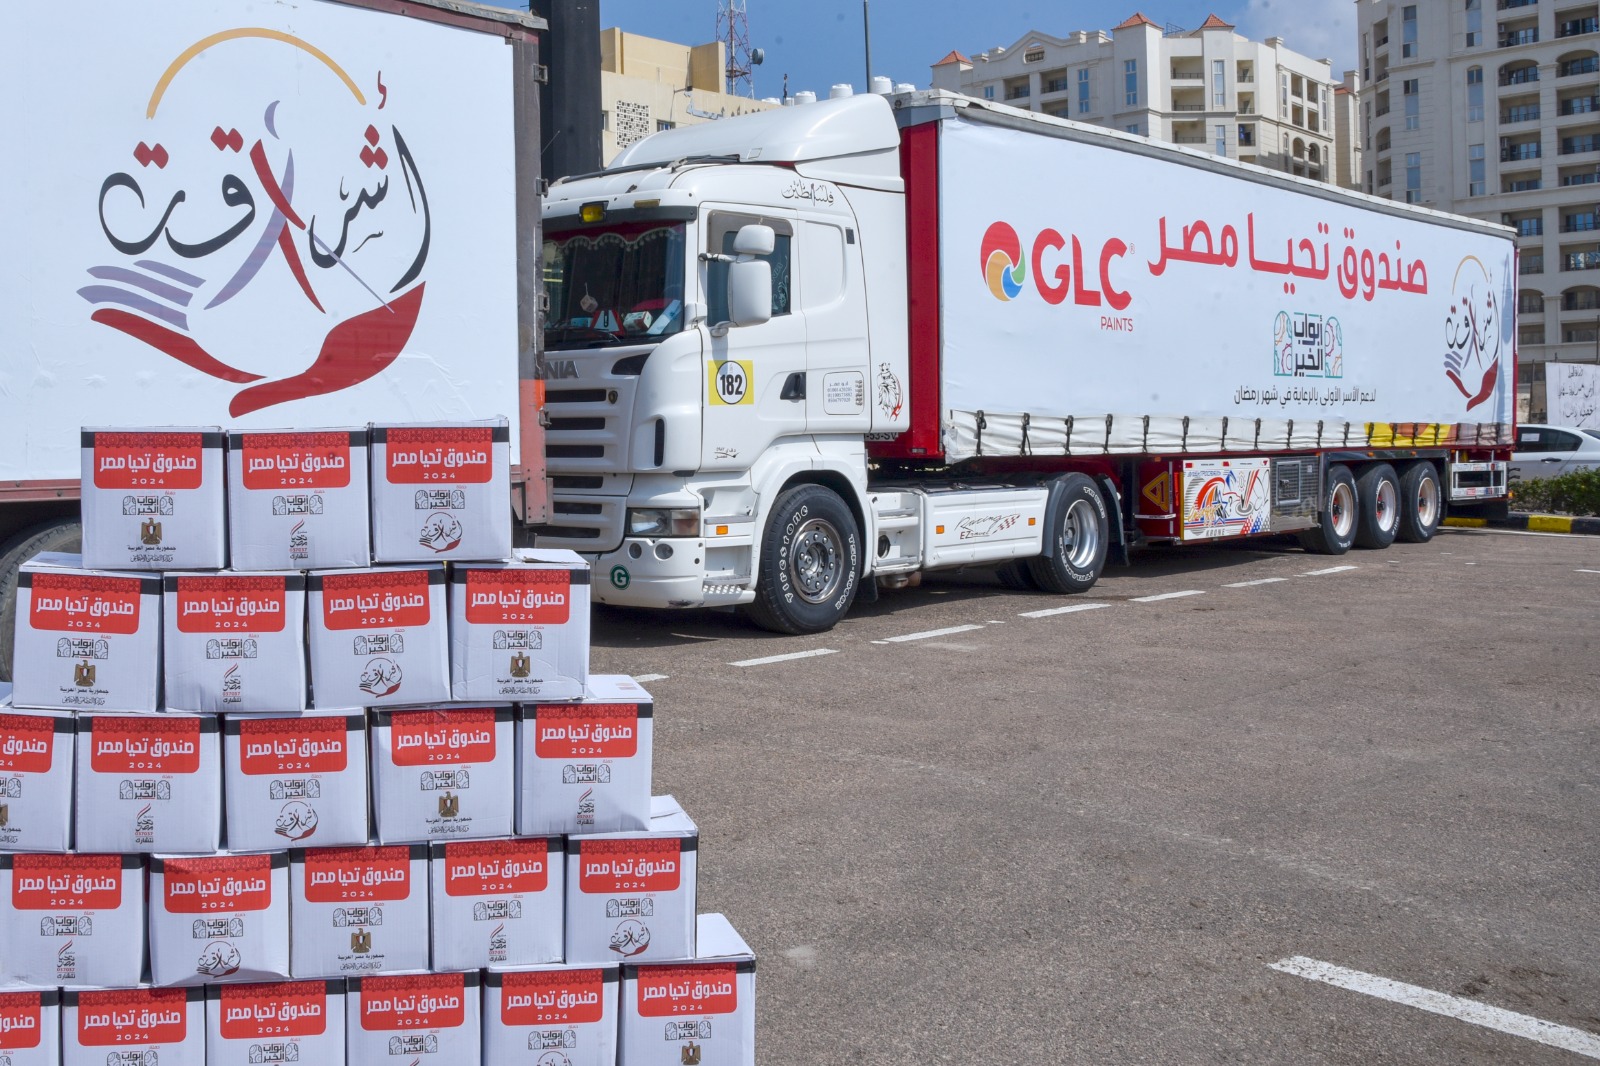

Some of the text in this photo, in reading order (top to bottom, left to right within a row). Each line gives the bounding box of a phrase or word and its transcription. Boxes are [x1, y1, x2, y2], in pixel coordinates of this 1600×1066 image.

[1147, 211, 1428, 301] صندوق تحيا مصر
[1031, 228, 1132, 311] GLC
[1100, 316, 1134, 332] PAINTS
[1294, 313, 1323, 346] أبواب
[1294, 348, 1323, 377] الخير
[720, 374, 743, 395] 182
[1234, 385, 1260, 405] رمضان
[1261, 385, 1278, 405] شهر
[1279, 386, 1291, 409] في
[1293, 386, 1319, 405] بالرعاية
[1342, 385, 1360, 406] الأسر
[1360, 388, 1377, 405] لدعم
[864, 432, 897, 441] -53-SV
[100, 453, 197, 473] صندوق تحيا مصر
[248, 453, 344, 474] صندوق تحيا مصر
[392, 448, 487, 468] صندوق تحيا مصر
[137, 505, 159, 515] الخير
[287, 505, 309, 515] الخير
[429, 499, 450, 509] الخير
[1205, 528, 1226, 538] KRONE
[779, 505, 808, 603] Firestone
[36, 596, 134, 617] صندوق تحيا مصر
[183, 597, 279, 616] صندوق تحيا مصر
[329, 592, 424, 614] صندوق تحيا مصر
[471, 589, 565, 609] صندوق تحيا مصر
[68, 620, 101, 628] 2024
[71, 648, 94, 659] الخير
[221, 648, 243, 659] الخير
[368, 644, 389, 655] الخير
[507, 639, 528, 650] الخير
[397, 729, 491, 750] صندوق تحيا مصر
[541, 724, 632, 743] صندوق تحيا مصر
[3, 736, 47, 755] صندوق
[97, 738, 194, 757] صندوق تحيا مصر
[246, 738, 342, 759] صندوق تحيا مصر
[278, 762, 310, 770] 2024
[434, 779, 456, 790] الخير
[576, 773, 597, 783] الخير
[134, 789, 156, 799] الخير
[284, 789, 306, 799] الخير
[310, 867, 405, 886] صندوق تحيا مصر
[451, 860, 542, 880] صندوق تحيا مصر
[585, 858, 675, 878] صندوق تحيا مصر
[18, 874, 116, 894] صندوق تحيا مصر
[170, 877, 266, 898] صندوق تحيا مصر
[347, 916, 368, 927] الخير
[620, 907, 640, 917] الخير
[55, 925, 77, 936] الخير
[207, 927, 229, 938] الخير
[507, 990, 598, 1011] صندوق تحيا مصر
[643, 981, 732, 1001] صندوق تحيا مصر
[226, 1001, 321, 1023] صندوق تحيا مصر
[366, 994, 459, 1015] صندوق تحيا مصر
[84, 1009, 181, 1030] صندوق تحيا مصر
[116, 1033, 149, 1041] 2024
[258, 1026, 289, 1034] 2024
[403, 1044, 424, 1055] الخير
[541, 1039, 563, 1049] الخير
[263, 1052, 285, 1063] الخير
